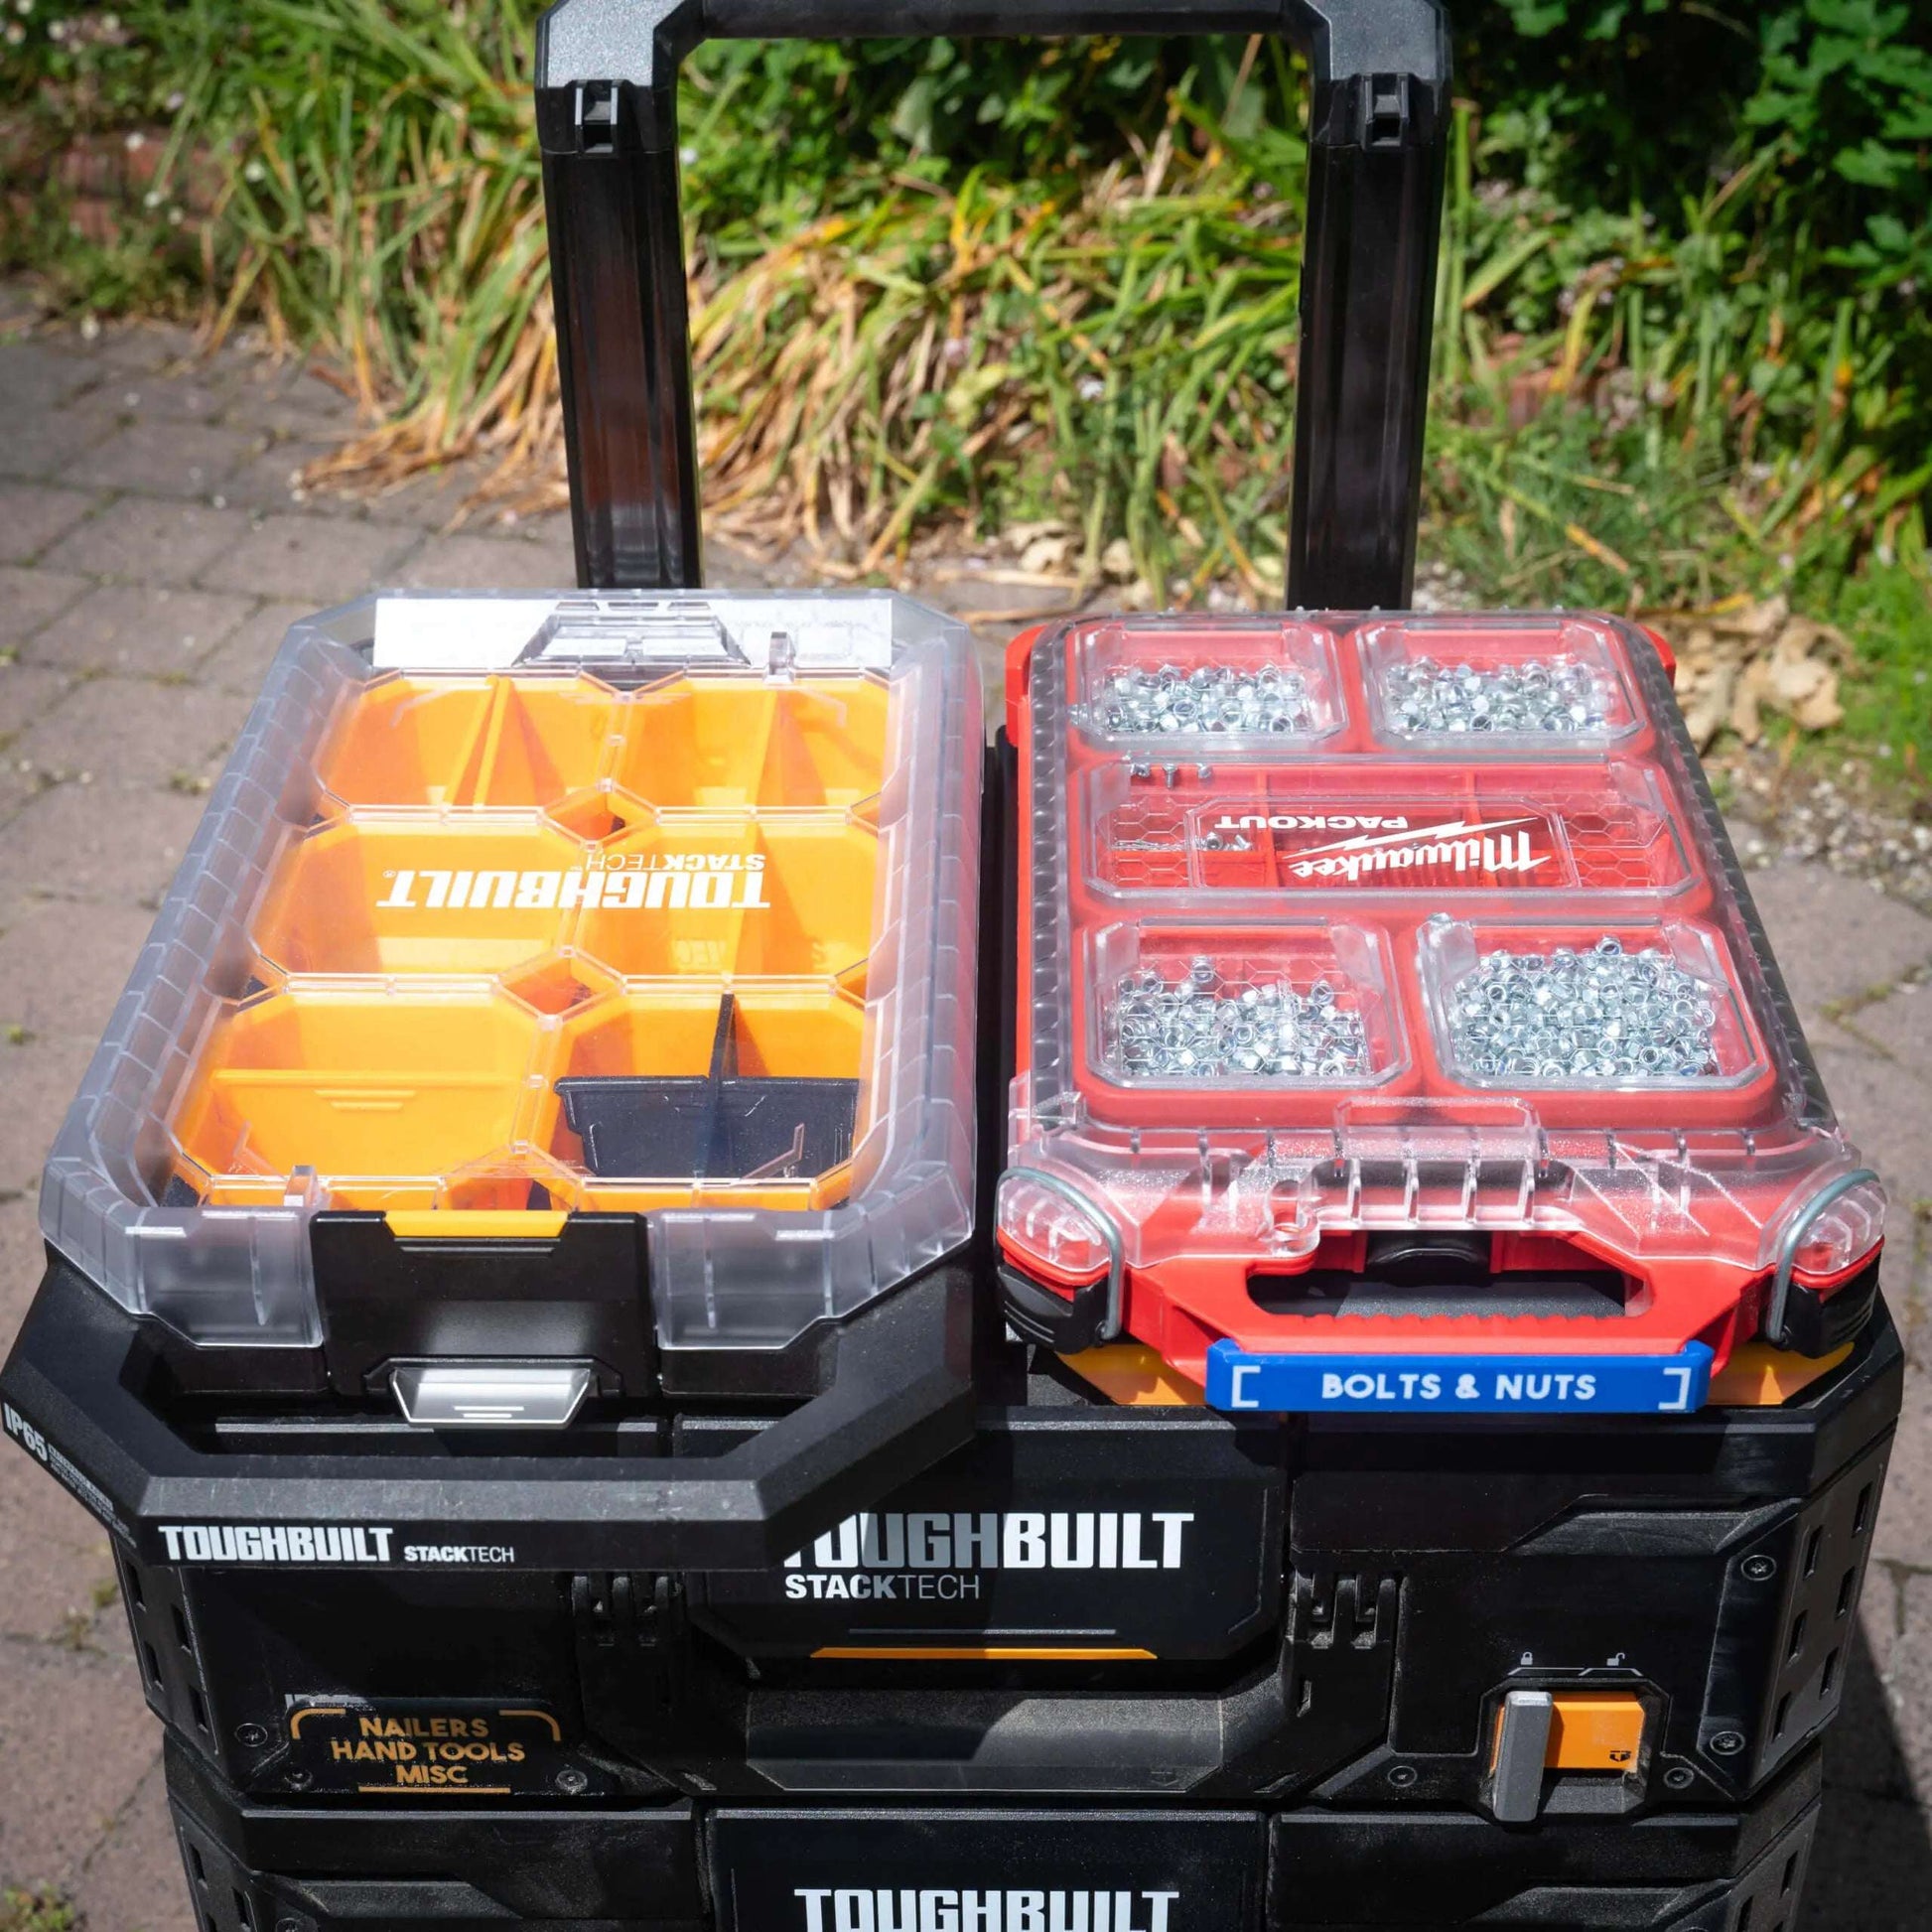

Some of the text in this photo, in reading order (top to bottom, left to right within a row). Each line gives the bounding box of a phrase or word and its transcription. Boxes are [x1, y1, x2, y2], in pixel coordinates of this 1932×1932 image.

[1214, 815, 1408, 829] PACKOUT
[1288, 830, 1552, 881] Milwaukee
[1321, 1373, 1596, 1400] BOLTS & NUTS
[3, 1402, 49, 1461] IP65
[158, 1525, 515, 1563] TOUGHBUILT STACKTECH
[785, 1574, 980, 1600] STACKTECH
[359, 1717, 489, 1737] NAILERS
[331, 1739, 525, 1761] HAND TOOLS
[396, 1763, 469, 1784] MISC
[794, 1889, 1179, 1932] TOUGHBUILT
